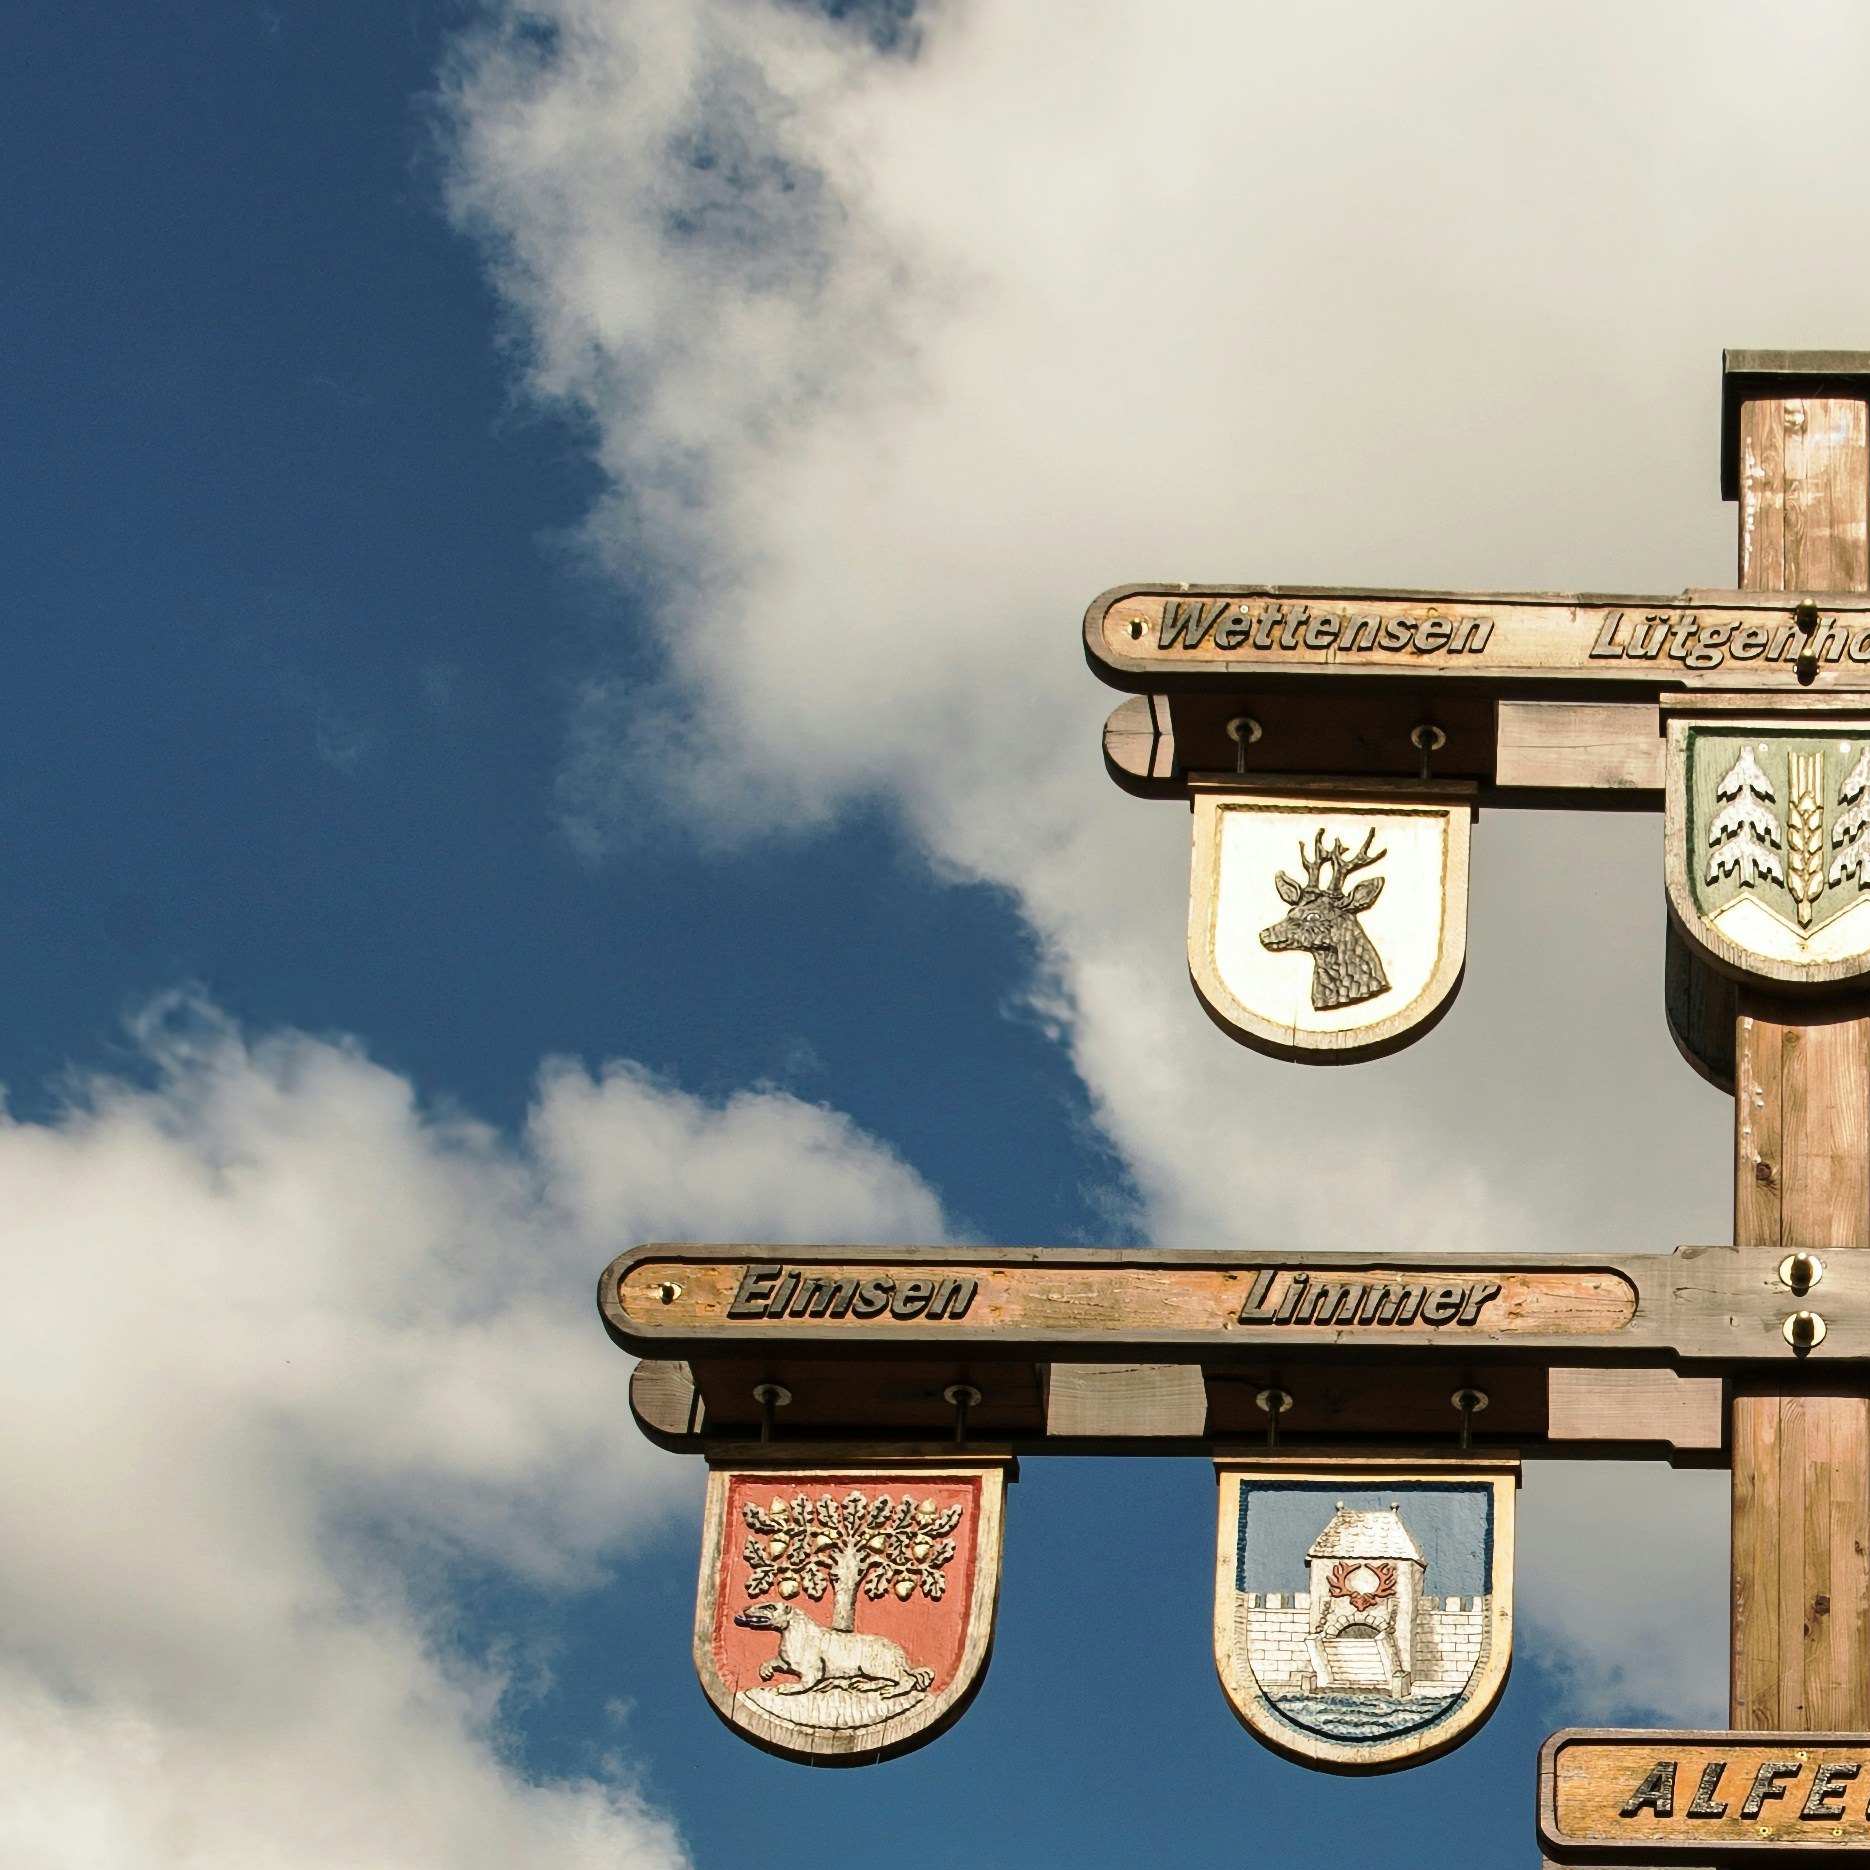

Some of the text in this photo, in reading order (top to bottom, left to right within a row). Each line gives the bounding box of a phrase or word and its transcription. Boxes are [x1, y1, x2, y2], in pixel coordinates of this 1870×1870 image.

[1157, 602, 1496, 655] Wettensen
[726, 1264, 978, 1320] Eimsen
[1237, 1269, 1502, 1327] Limmer
